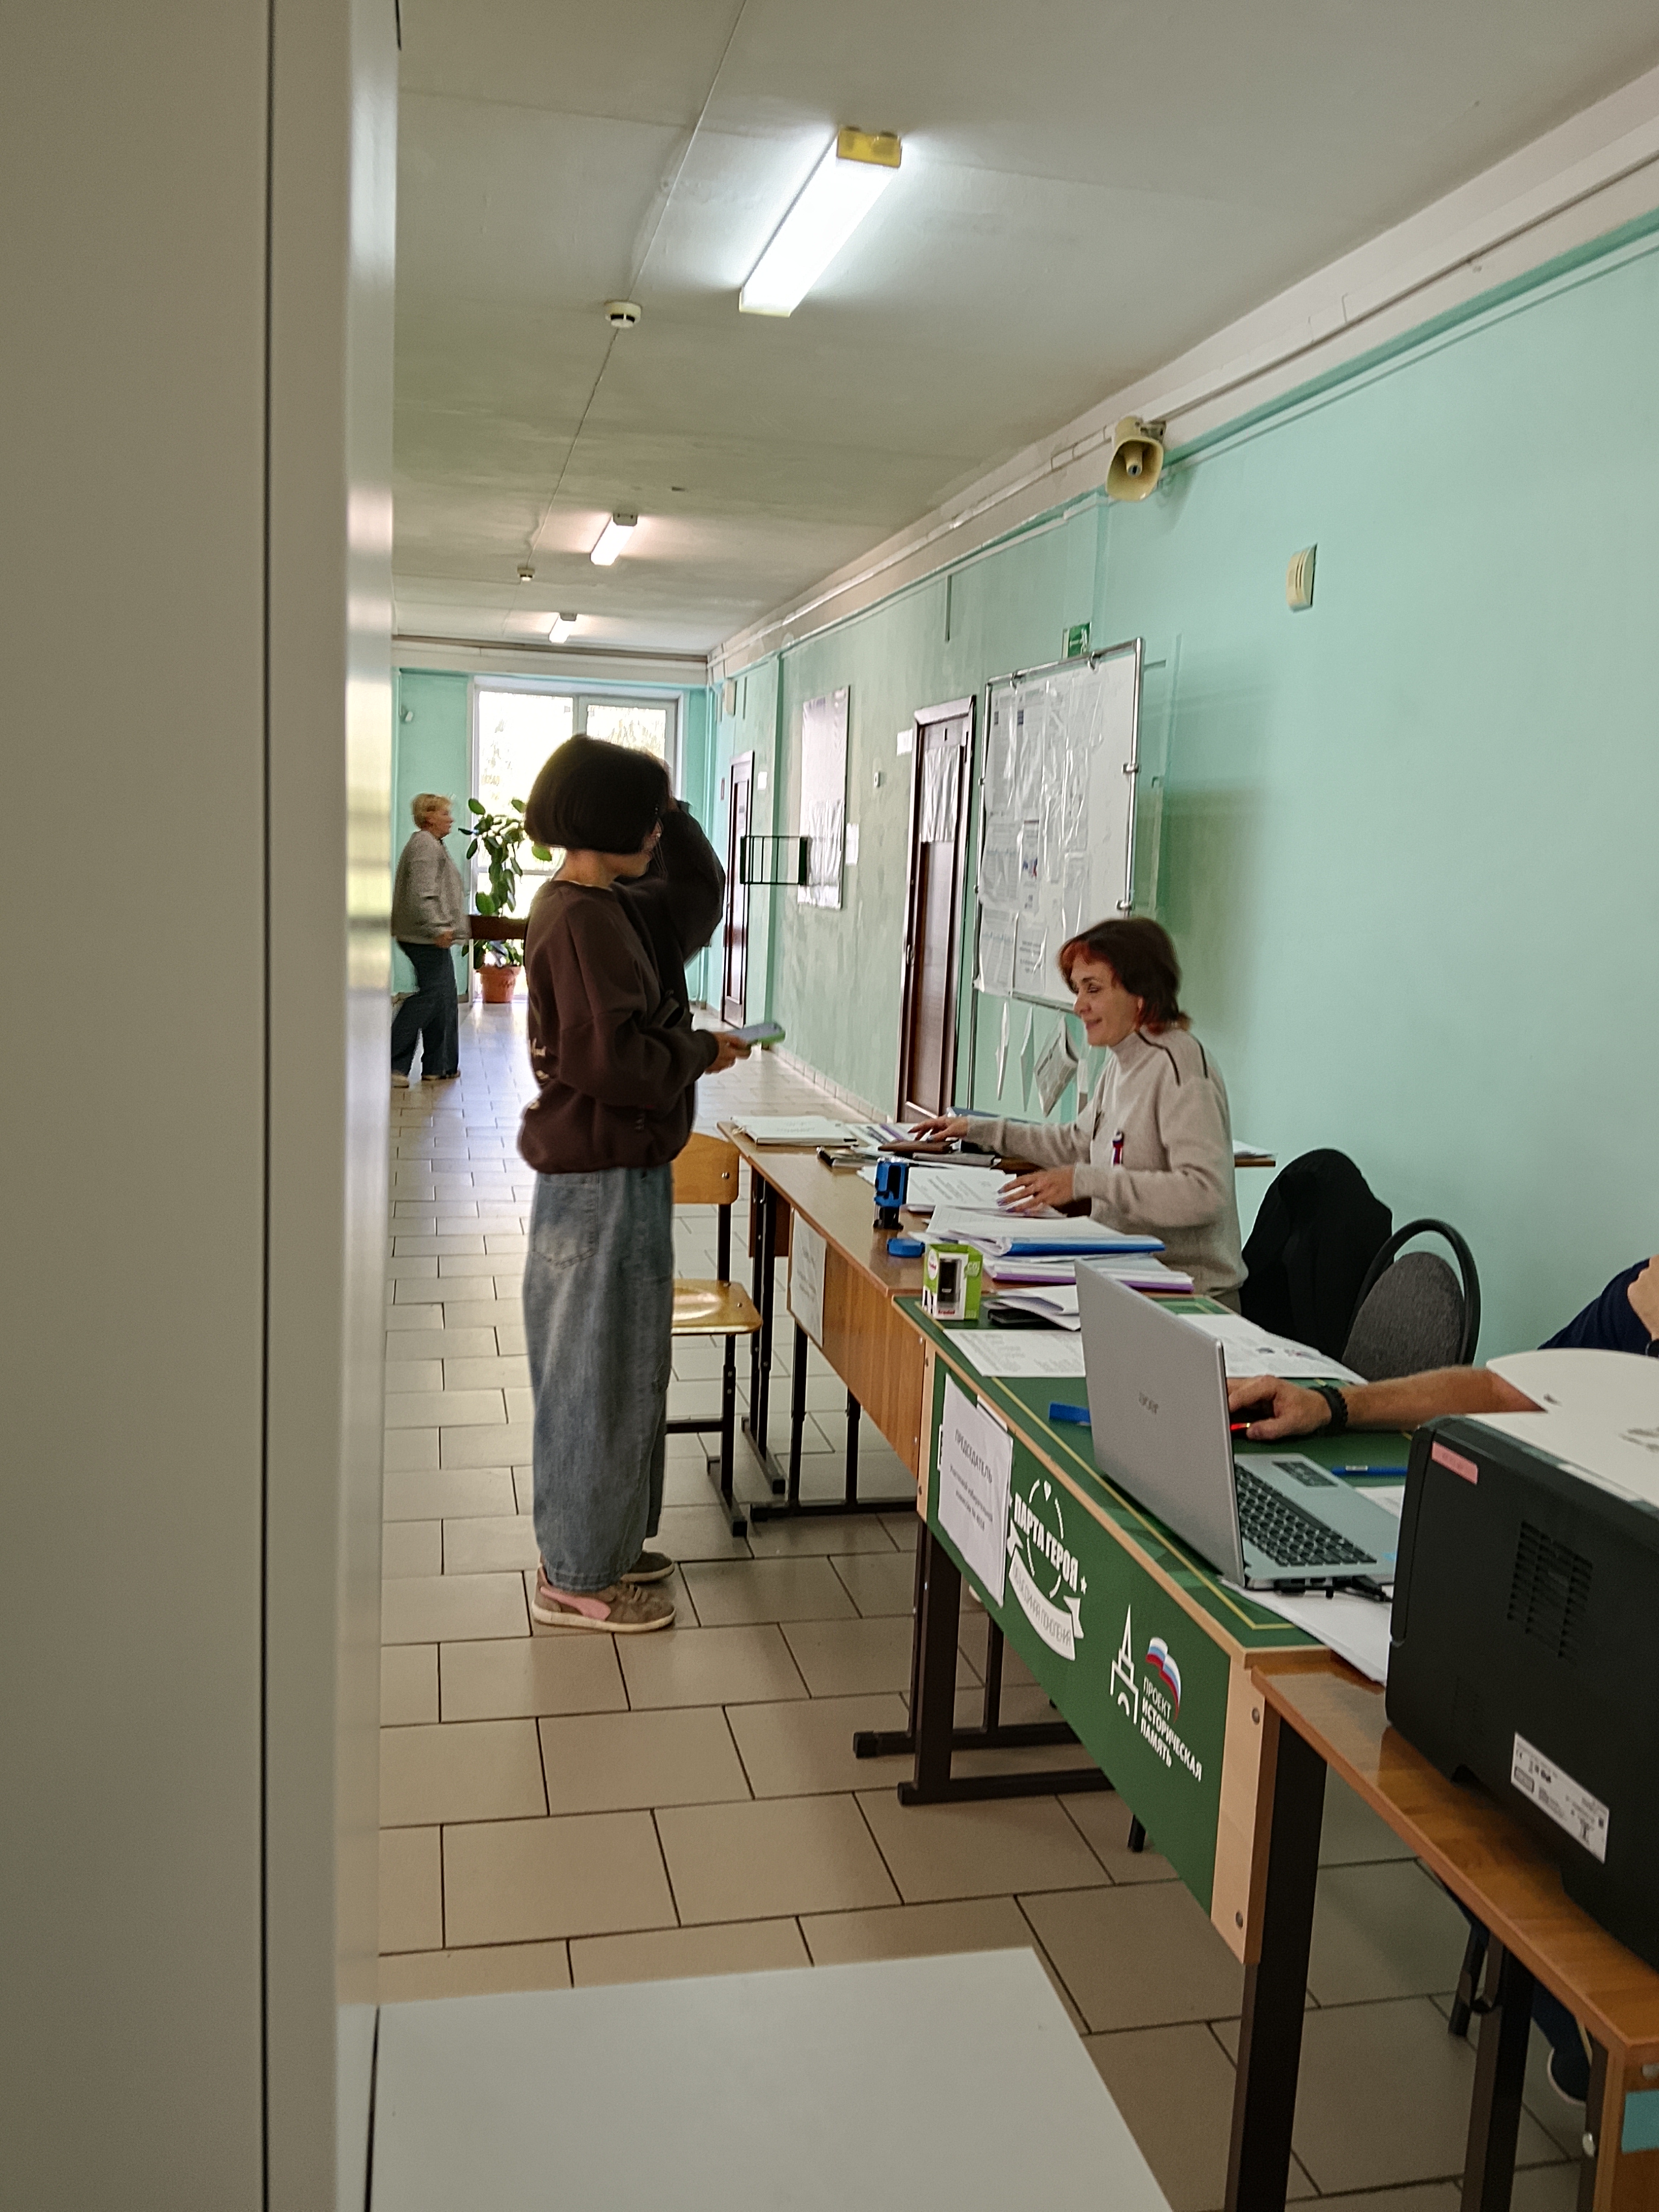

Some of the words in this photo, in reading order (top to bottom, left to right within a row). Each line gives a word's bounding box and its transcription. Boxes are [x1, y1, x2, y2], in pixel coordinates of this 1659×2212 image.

[955, 1429, 992, 1483] ПРЕДСЕДАТЕЛЬ
[1014, 1492, 1045, 1553] ПАРТА
[1045, 1530, 1079, 1593] ГЕРОЯ
[1143, 1675, 1171, 1721] ПРОЕКТ
[1140, 1716, 1172, 1768] ПАМЯТЬ
[1142, 1696, 1202, 1782] ИСТОРИЧЕСКАЯ
